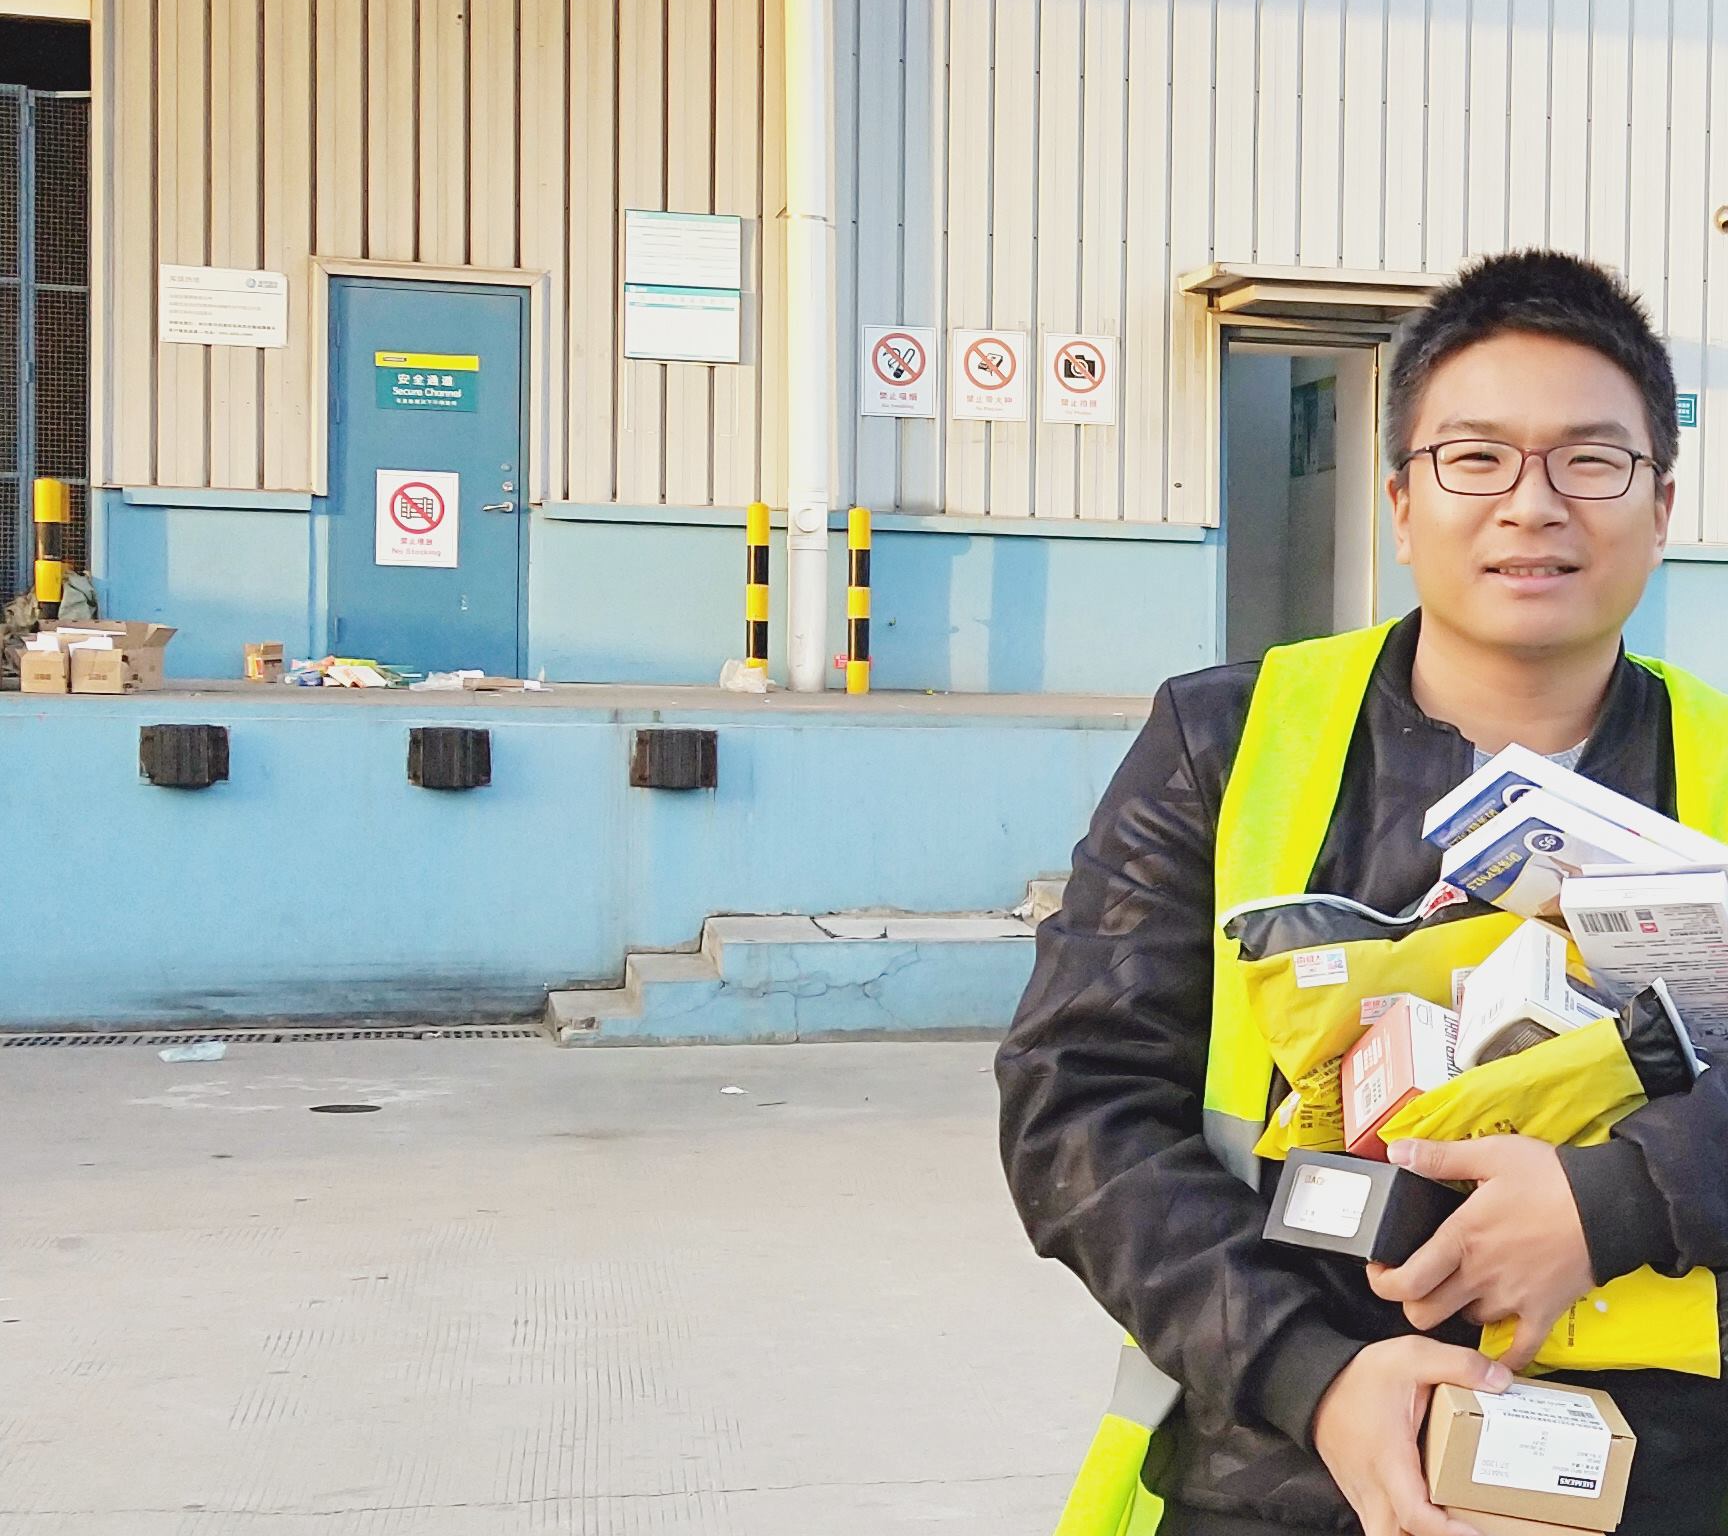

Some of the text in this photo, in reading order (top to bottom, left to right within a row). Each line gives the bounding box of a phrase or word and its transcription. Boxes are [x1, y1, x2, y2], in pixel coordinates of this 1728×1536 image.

[397, 373, 453, 387] 安全通道
[1559, 1476, 1595, 1489] SIEMENS
